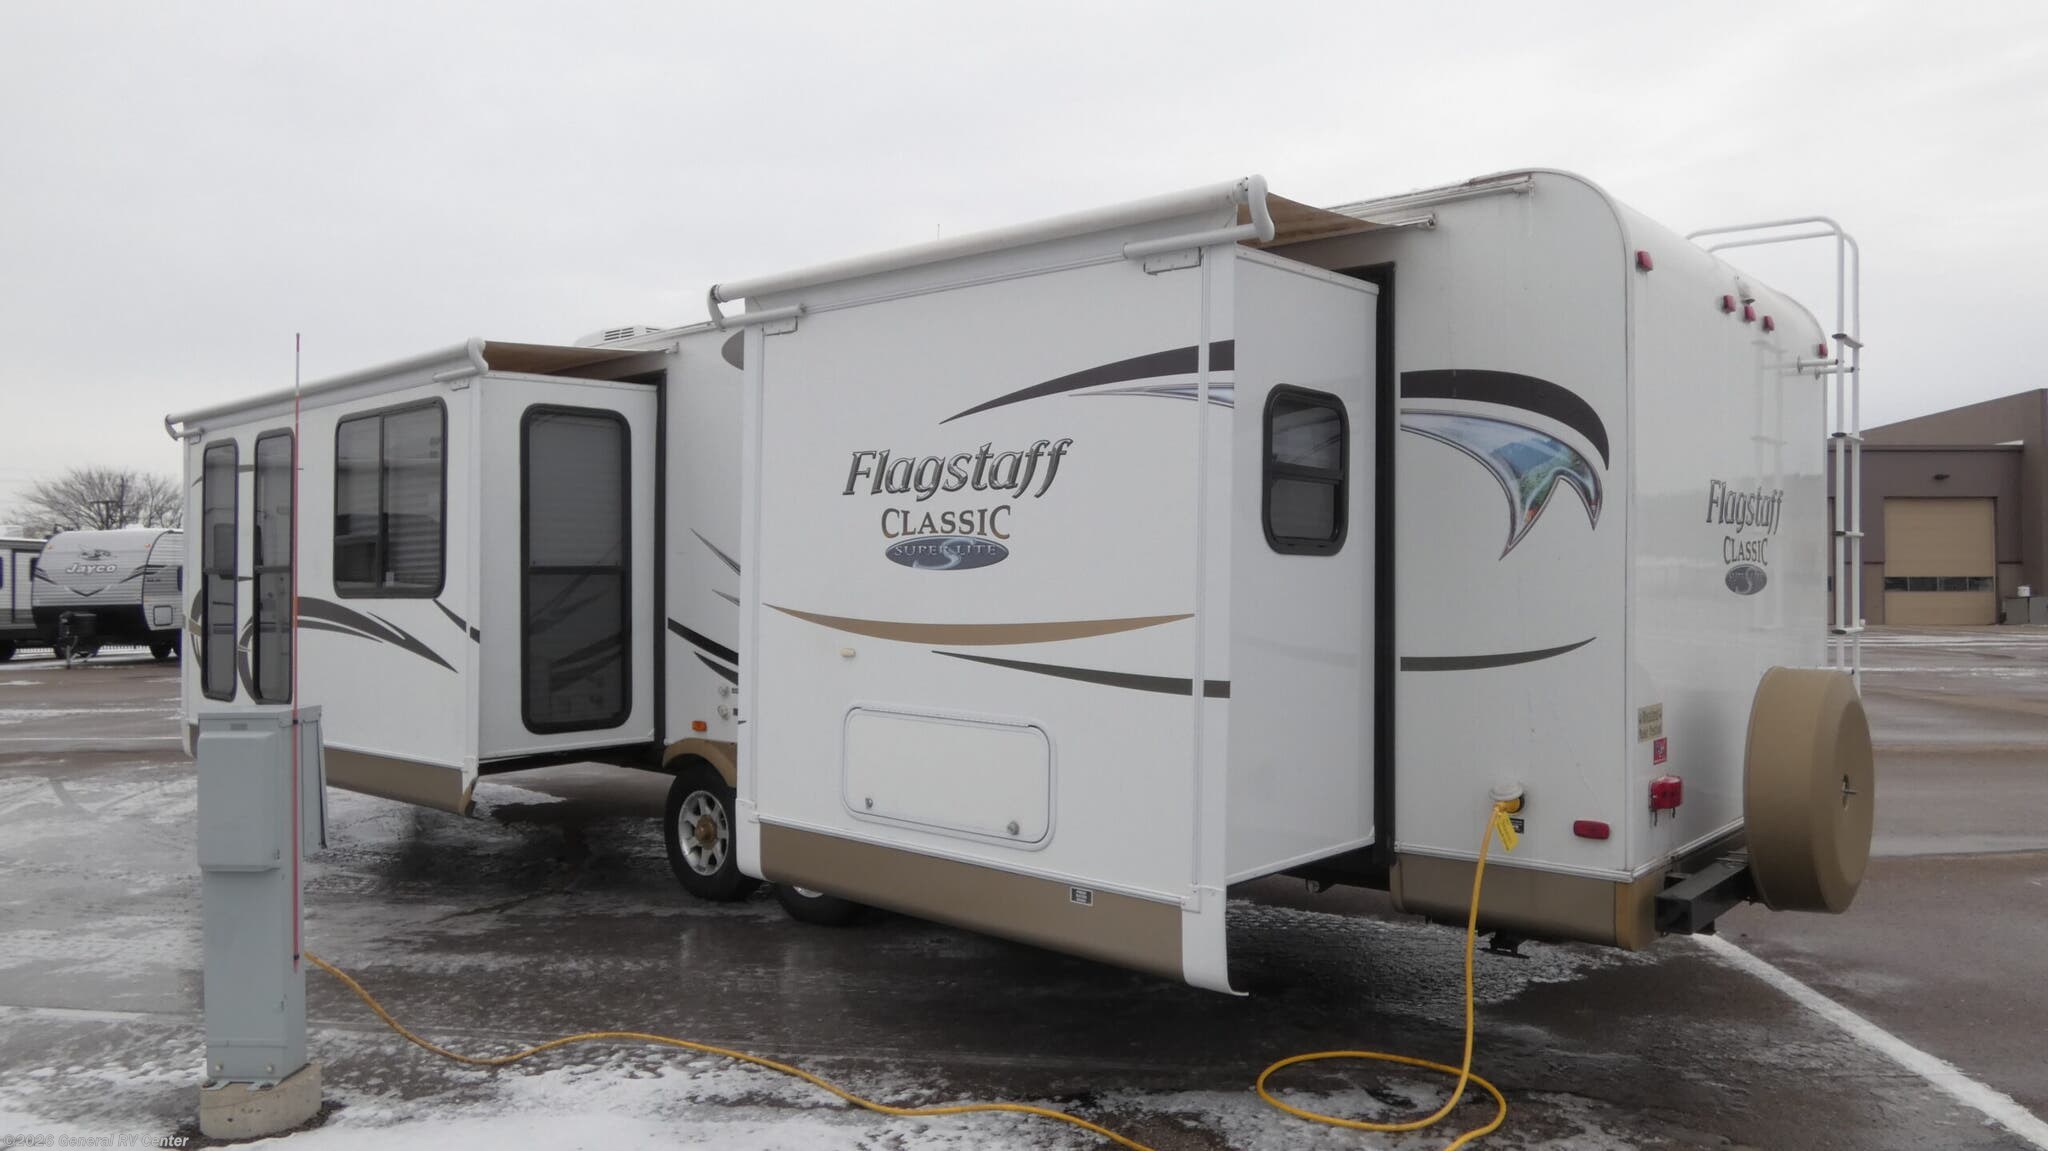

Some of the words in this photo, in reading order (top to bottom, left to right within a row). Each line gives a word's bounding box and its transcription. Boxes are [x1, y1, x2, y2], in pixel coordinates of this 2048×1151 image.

[842, 438, 1073, 502] Flagstaff
[881, 505, 1011, 539] CLASSIC
[1706, 479, 1784, 535] Flagstaff
[894, 544, 950, 557] SUPER
[956, 544, 997, 555] LITE
[1723, 535, 1768, 566] CLASSIC
[66, 563, 118, 575] Jayco
